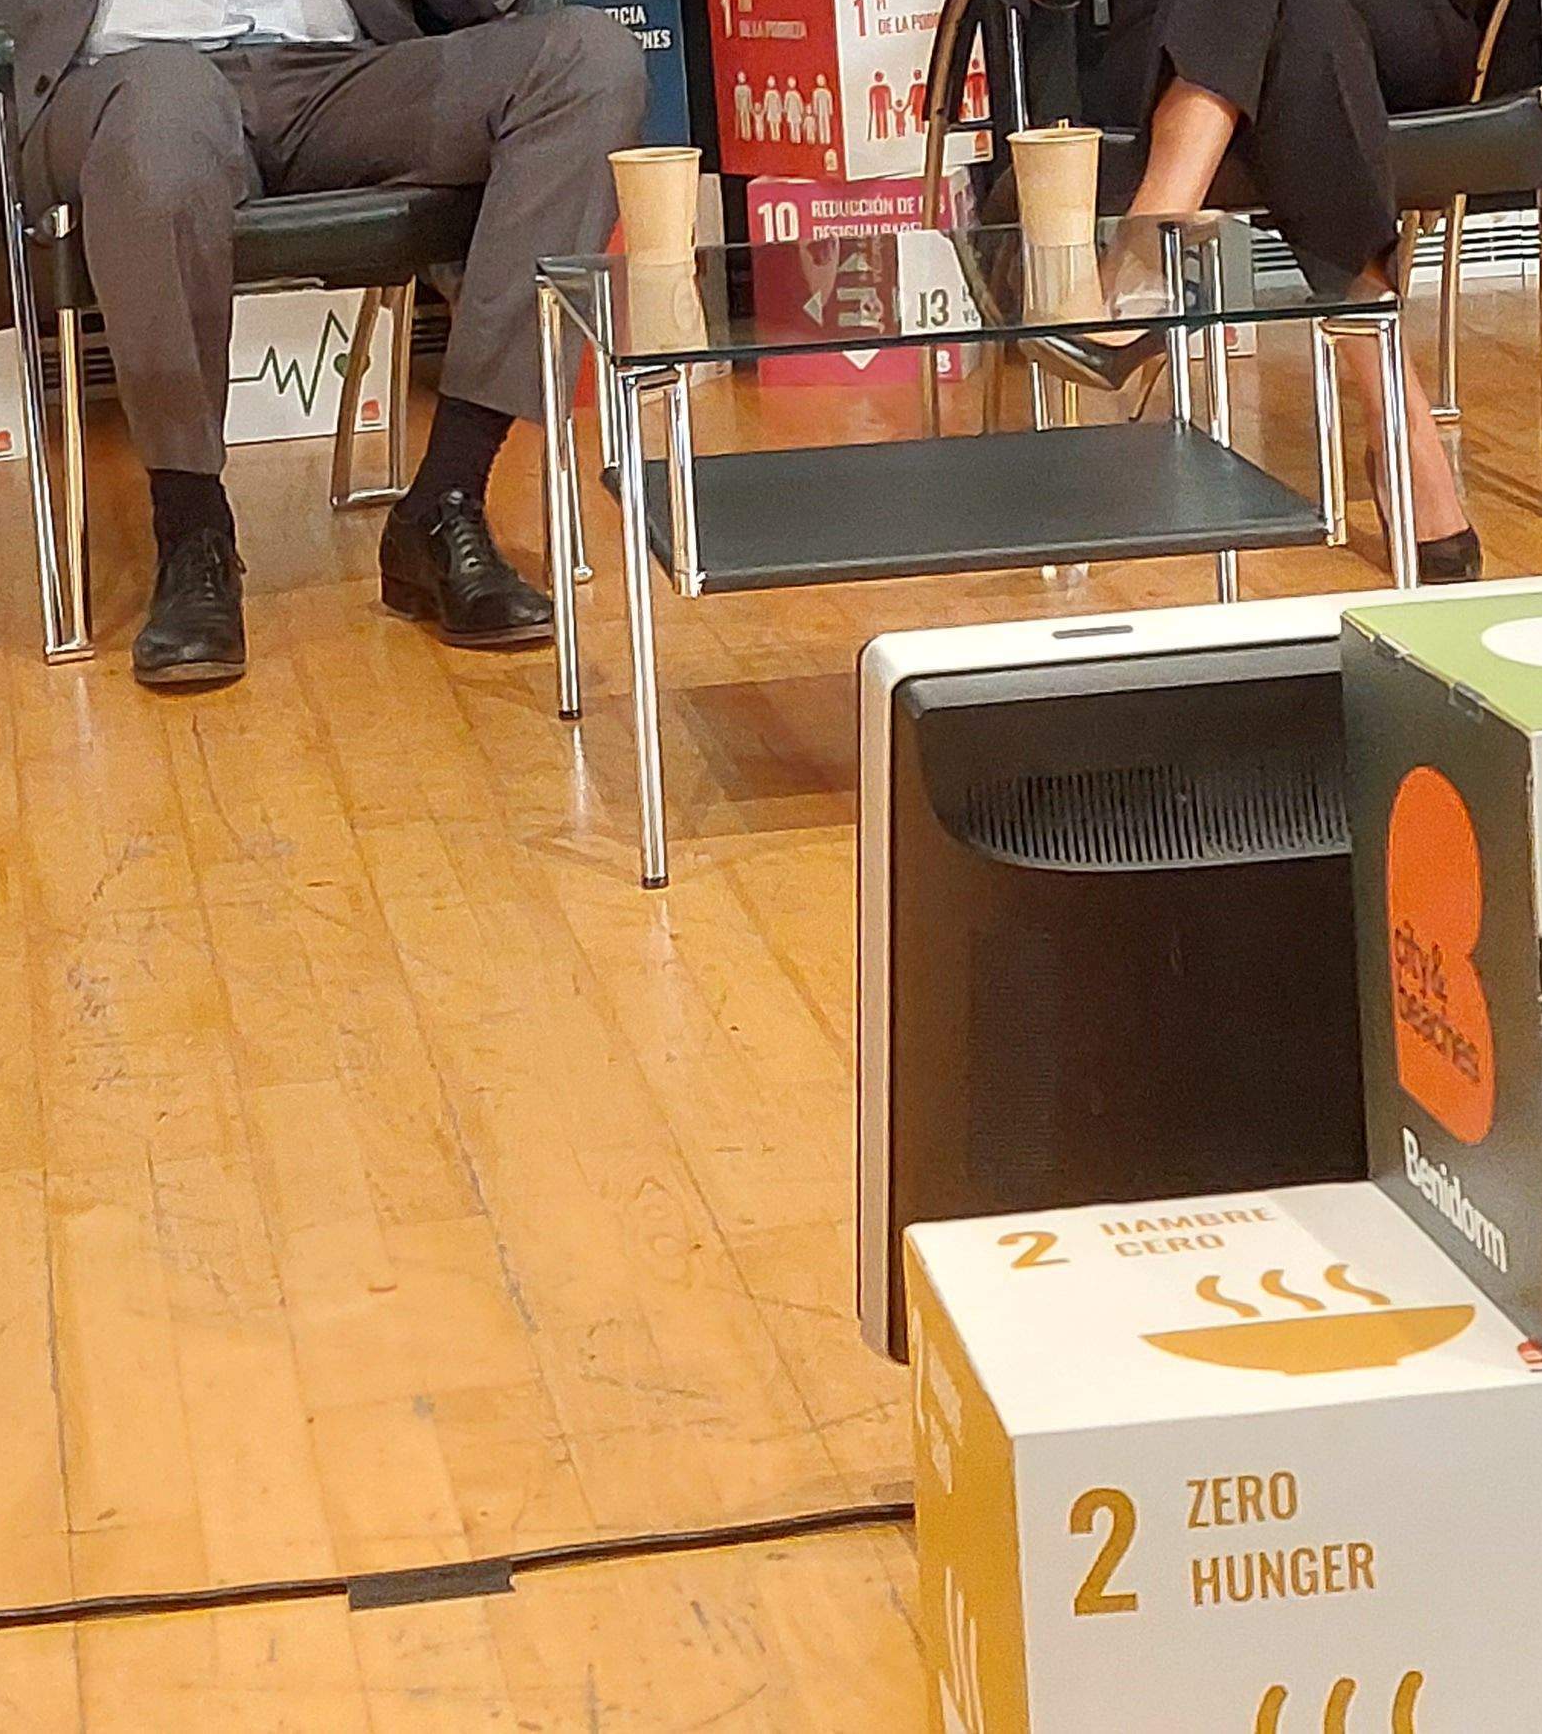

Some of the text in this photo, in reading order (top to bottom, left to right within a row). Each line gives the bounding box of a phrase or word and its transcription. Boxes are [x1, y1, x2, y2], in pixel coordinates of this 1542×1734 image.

[757, 201, 800, 243] 10
[810, 195, 894, 219] REDUCCIÓN
[896, 196, 918, 215] DE
[1402, 1124, 1508, 1274] Benidorm
[1099, 1206, 1278, 1237] HAMBRE
[996, 1230, 1071, 1270] 2
[1114, 1233, 1226, 1258] CERO
[1186, 1470, 1298, 1529] ZERO
[1068, 1486, 1140, 1617] 2
[1191, 1541, 1377, 1608] HUNGER
